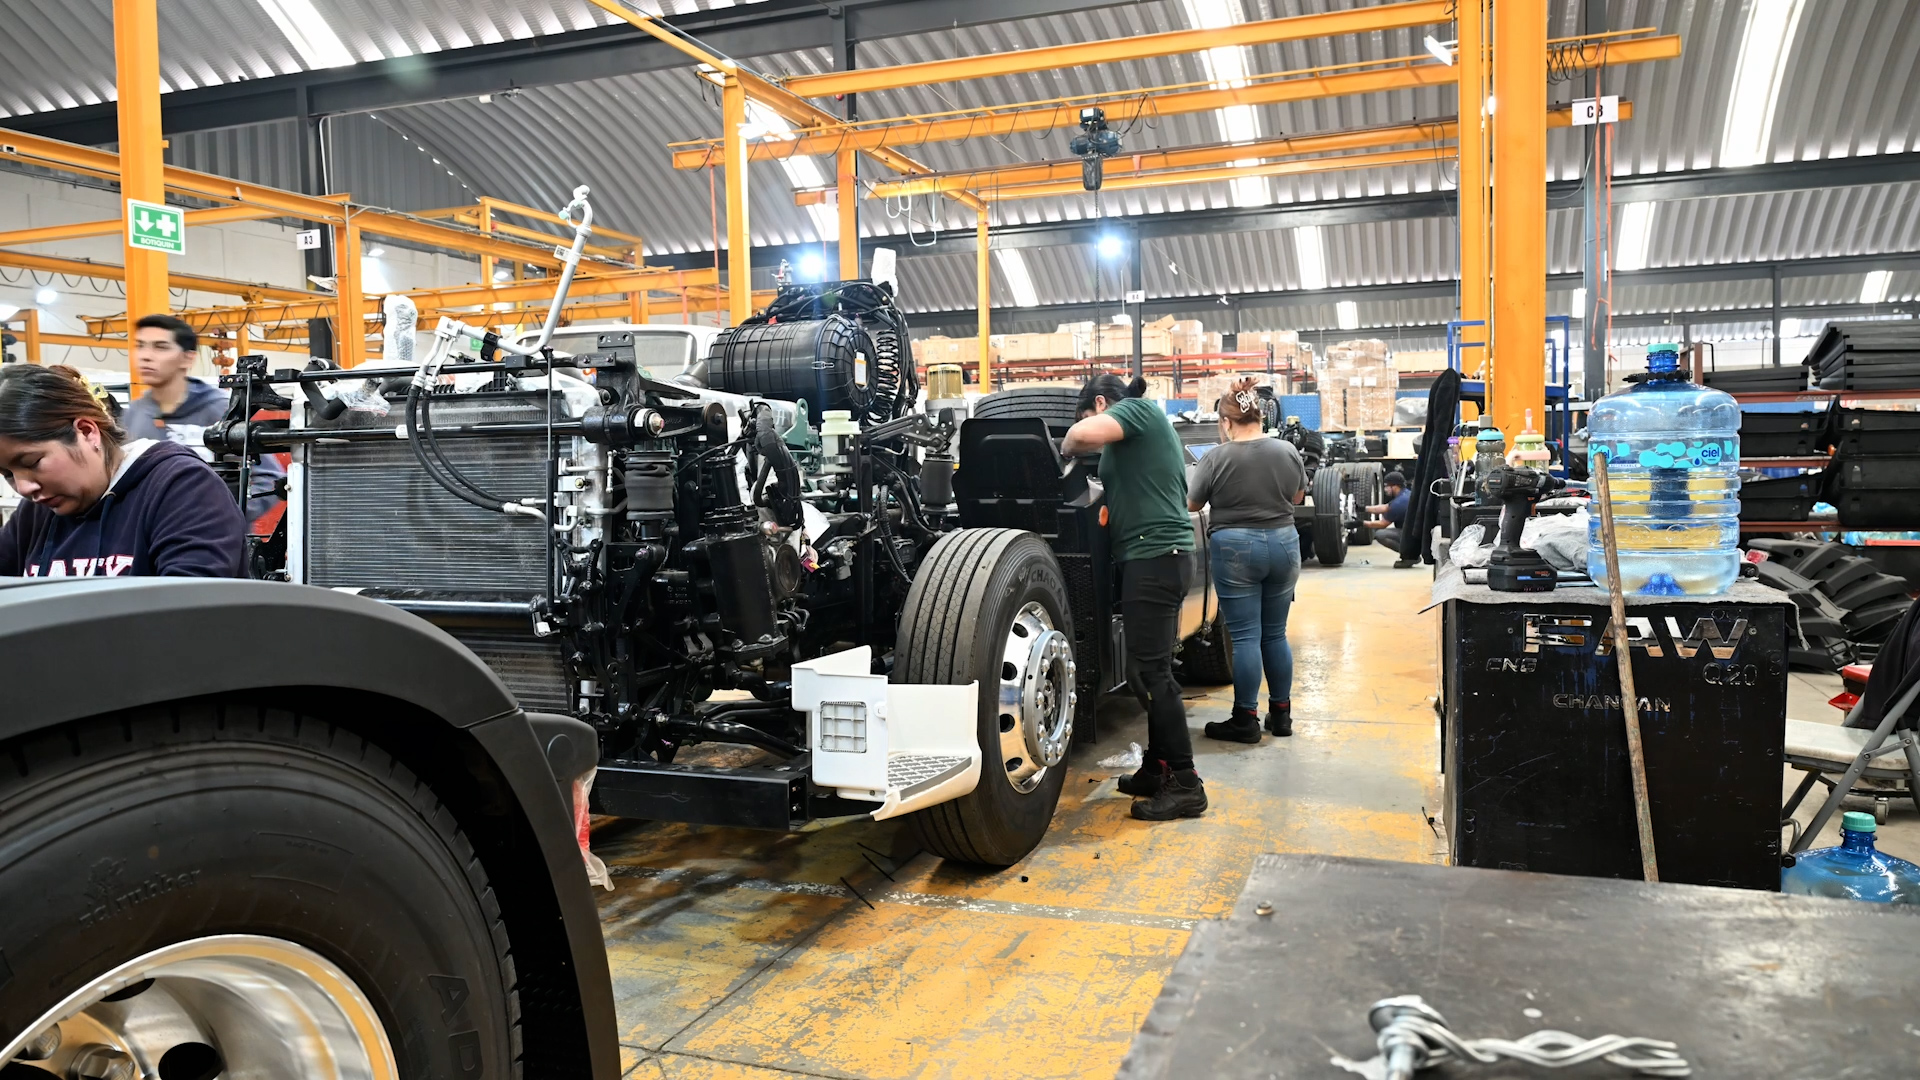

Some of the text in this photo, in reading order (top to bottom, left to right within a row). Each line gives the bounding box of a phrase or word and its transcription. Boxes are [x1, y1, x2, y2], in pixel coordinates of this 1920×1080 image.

[304, 235, 313, 245] A3
[1701, 447, 1720, 458] ciel
[1523, 614, 1748, 659] FAW
[1485, 657, 1538, 675] CNG
[1703, 662, 1759, 686] Q20
[1552, 693, 1671, 712] CHANAN
